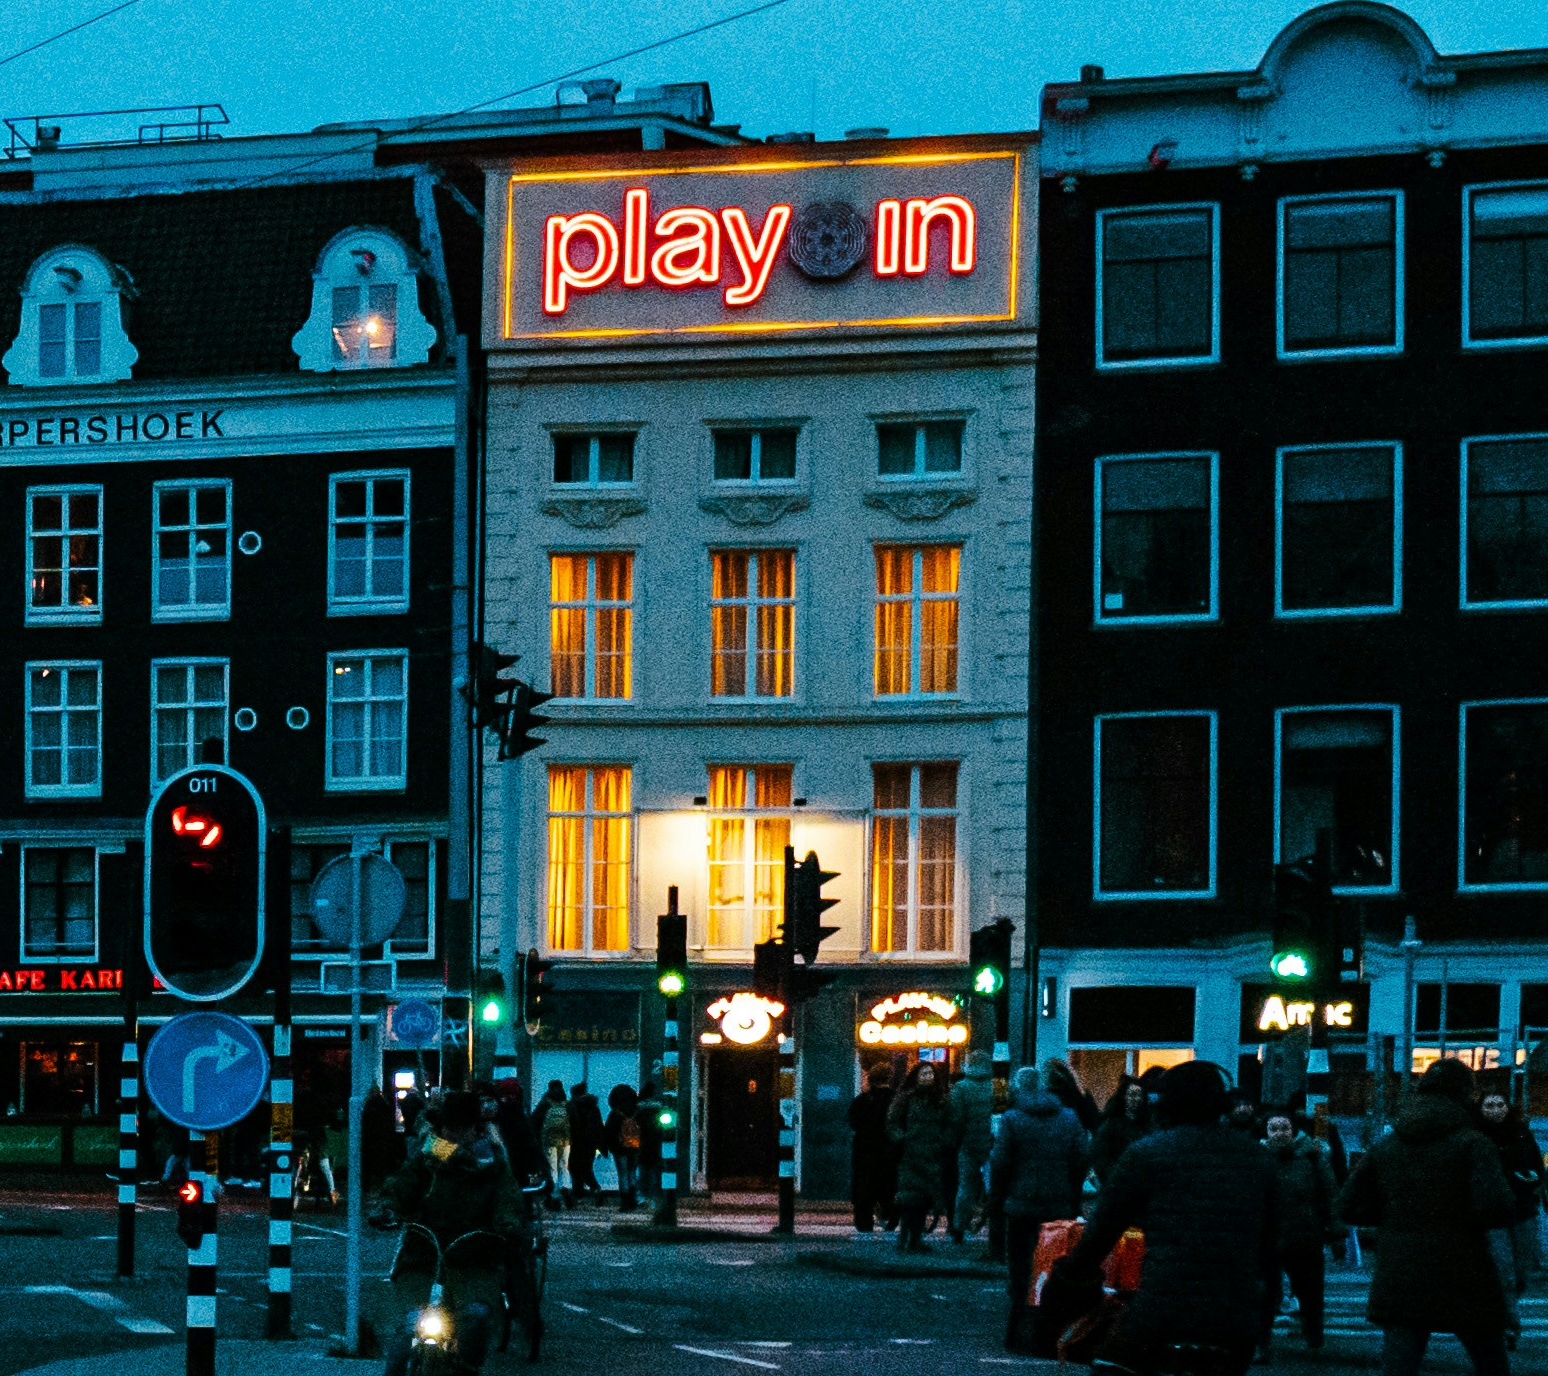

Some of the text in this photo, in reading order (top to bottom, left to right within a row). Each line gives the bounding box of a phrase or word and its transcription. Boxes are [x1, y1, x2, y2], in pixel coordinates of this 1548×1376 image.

[543, 187, 975, 314] play in
[189, 777, 217, 793] 011
